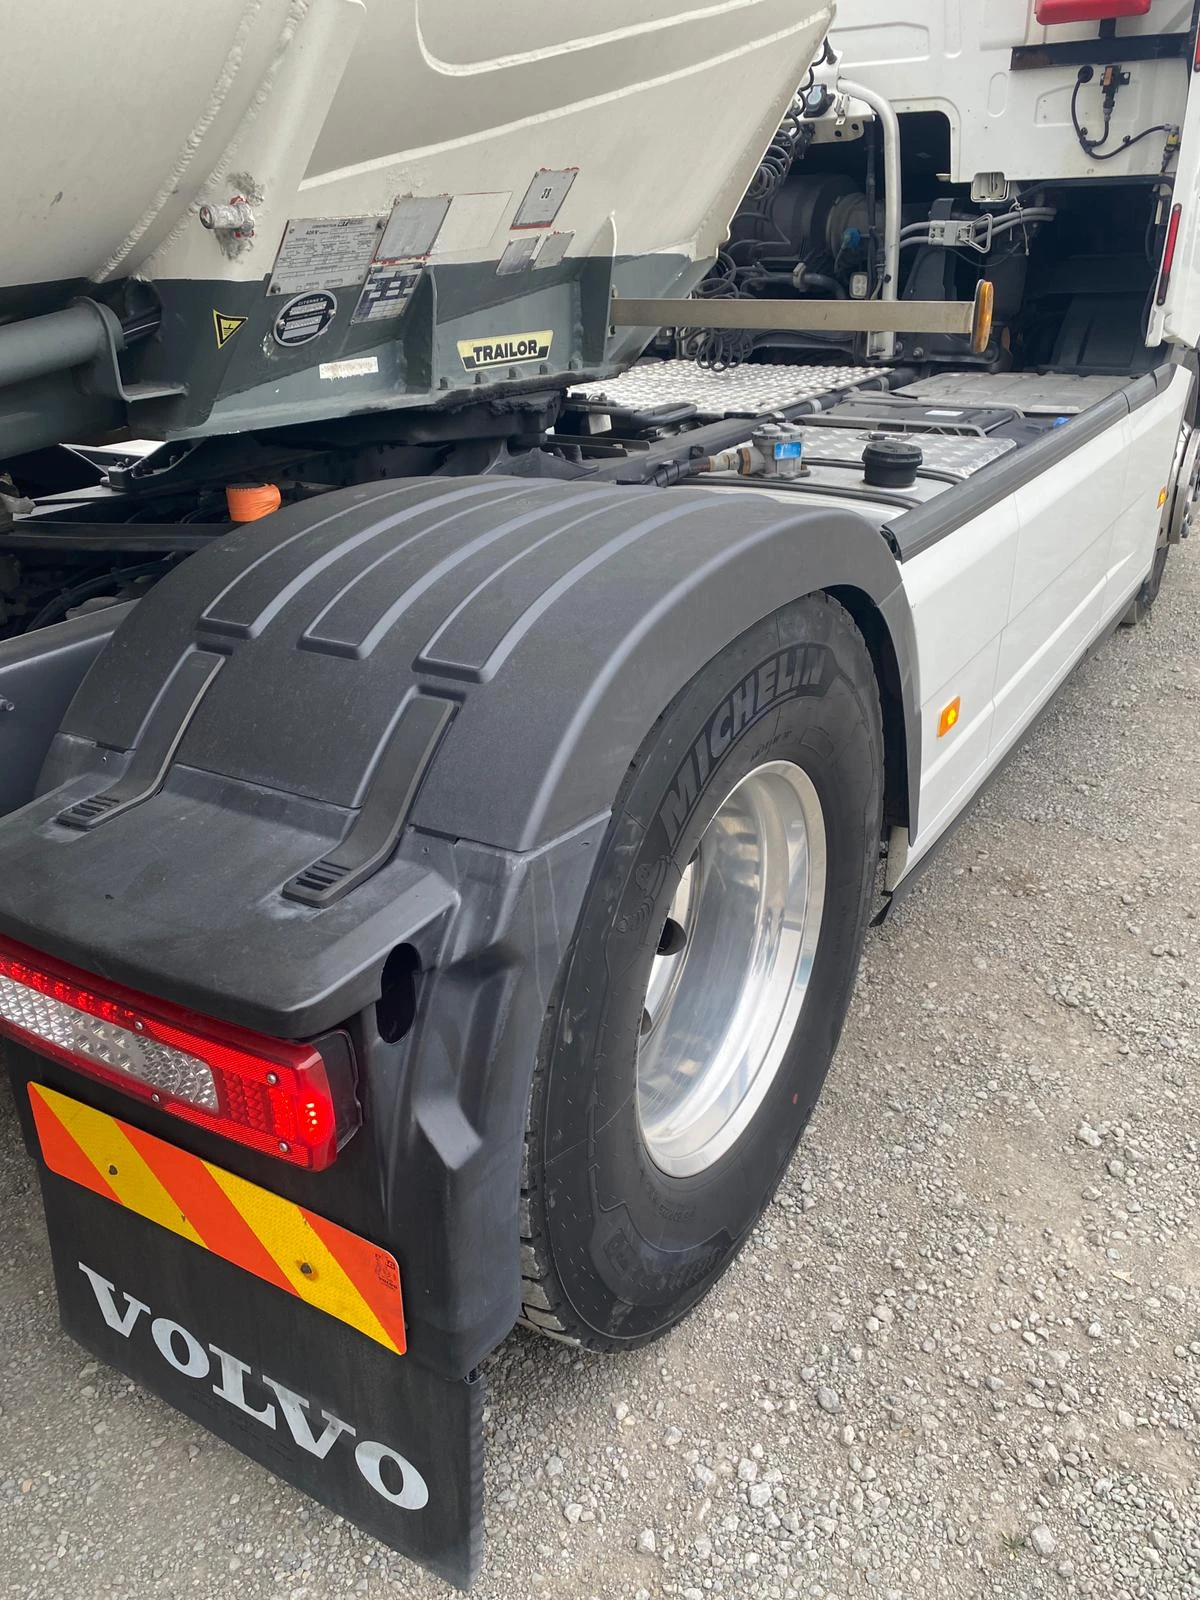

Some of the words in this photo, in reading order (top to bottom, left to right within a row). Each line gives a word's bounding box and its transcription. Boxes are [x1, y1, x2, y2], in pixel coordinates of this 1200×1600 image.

[473, 339, 538, 362] TRAILOR
[659, 645, 826, 846] MICHELIN
[78, 1261, 429, 1511] VOLVO
